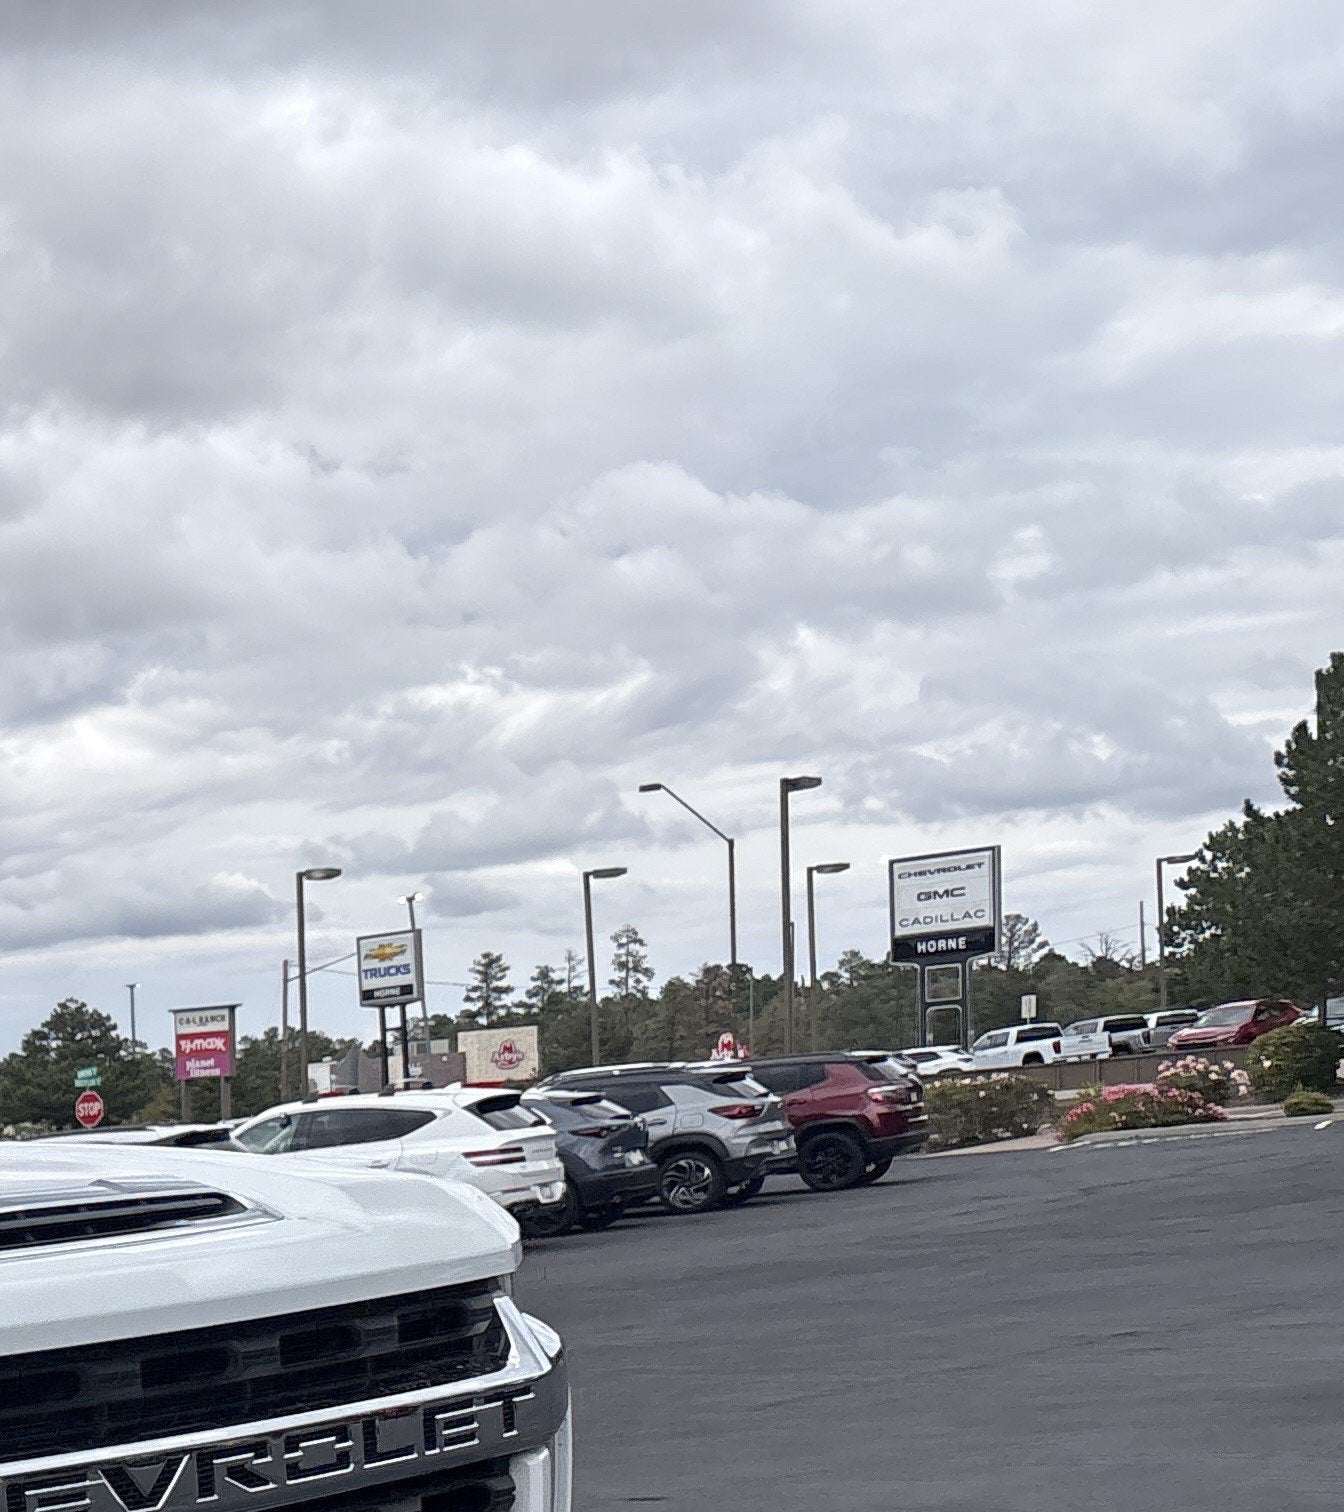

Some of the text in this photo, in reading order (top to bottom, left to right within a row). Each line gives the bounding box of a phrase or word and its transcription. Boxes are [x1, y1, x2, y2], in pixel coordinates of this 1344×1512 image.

[898, 862, 984, 879] CHEVROLET
[917, 887, 966, 902] GMC
[899, 909, 986, 928] CADILLAC
[916, 937, 967, 953] HORNE
[362, 963, 411, 979] TRUCKS
[186, 1058, 214, 1071] planet
[77, 1102, 102, 1117] STOP
